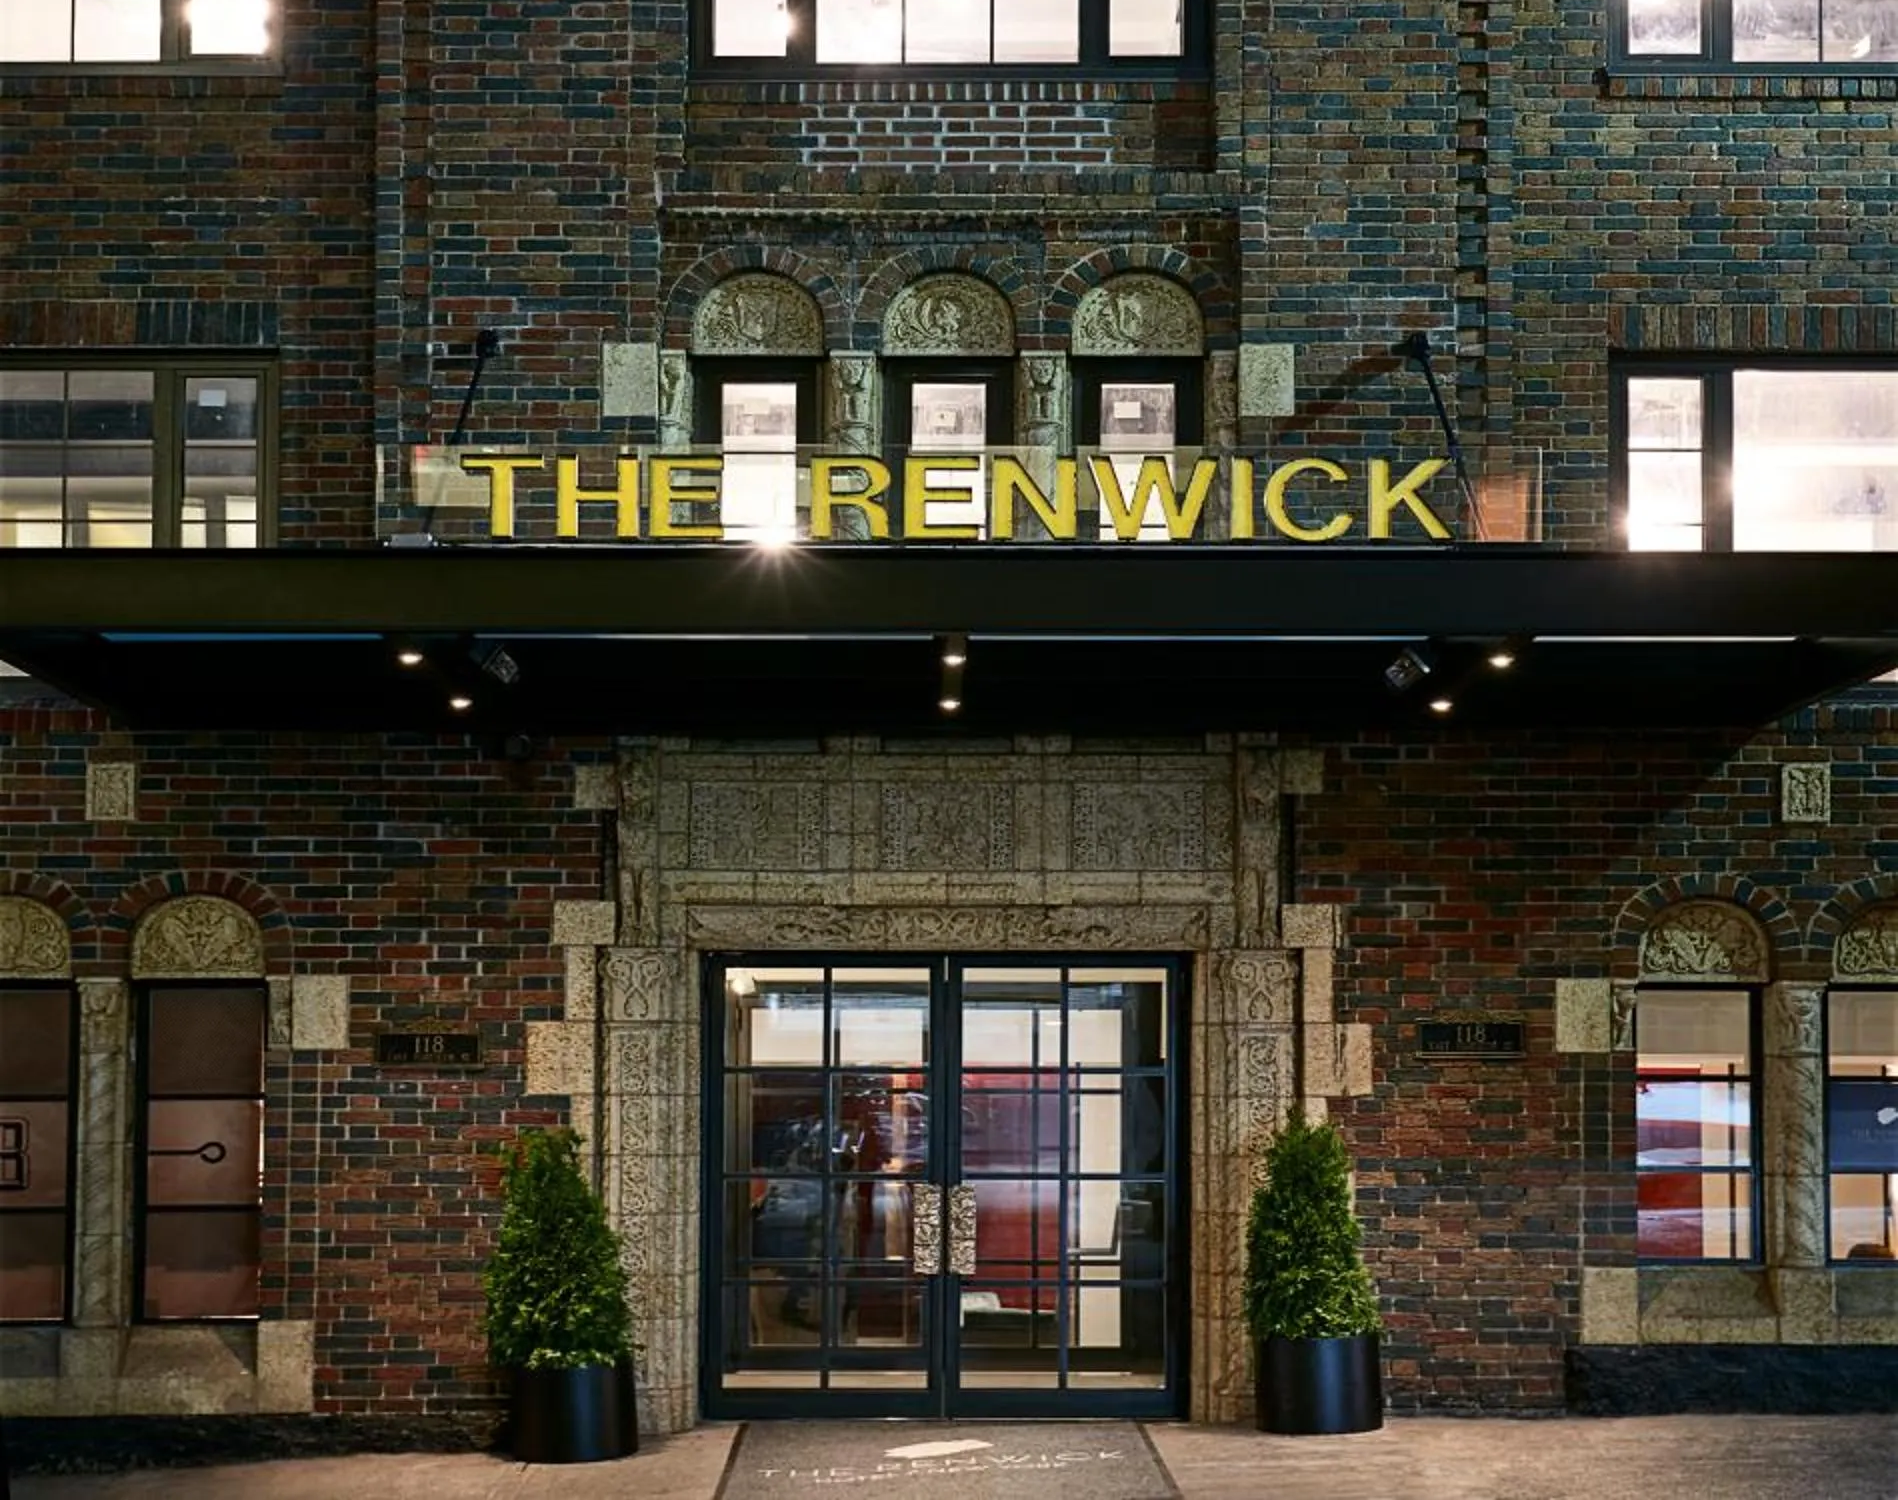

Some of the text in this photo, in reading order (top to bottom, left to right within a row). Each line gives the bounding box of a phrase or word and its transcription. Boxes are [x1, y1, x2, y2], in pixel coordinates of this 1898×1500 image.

[460, 453, 1455, 541] THE RENWICK
[1456, 1025, 1486, 1043] 118
[414, 1035, 445, 1053] 118
[757, 1466, 857, 1478] THE
